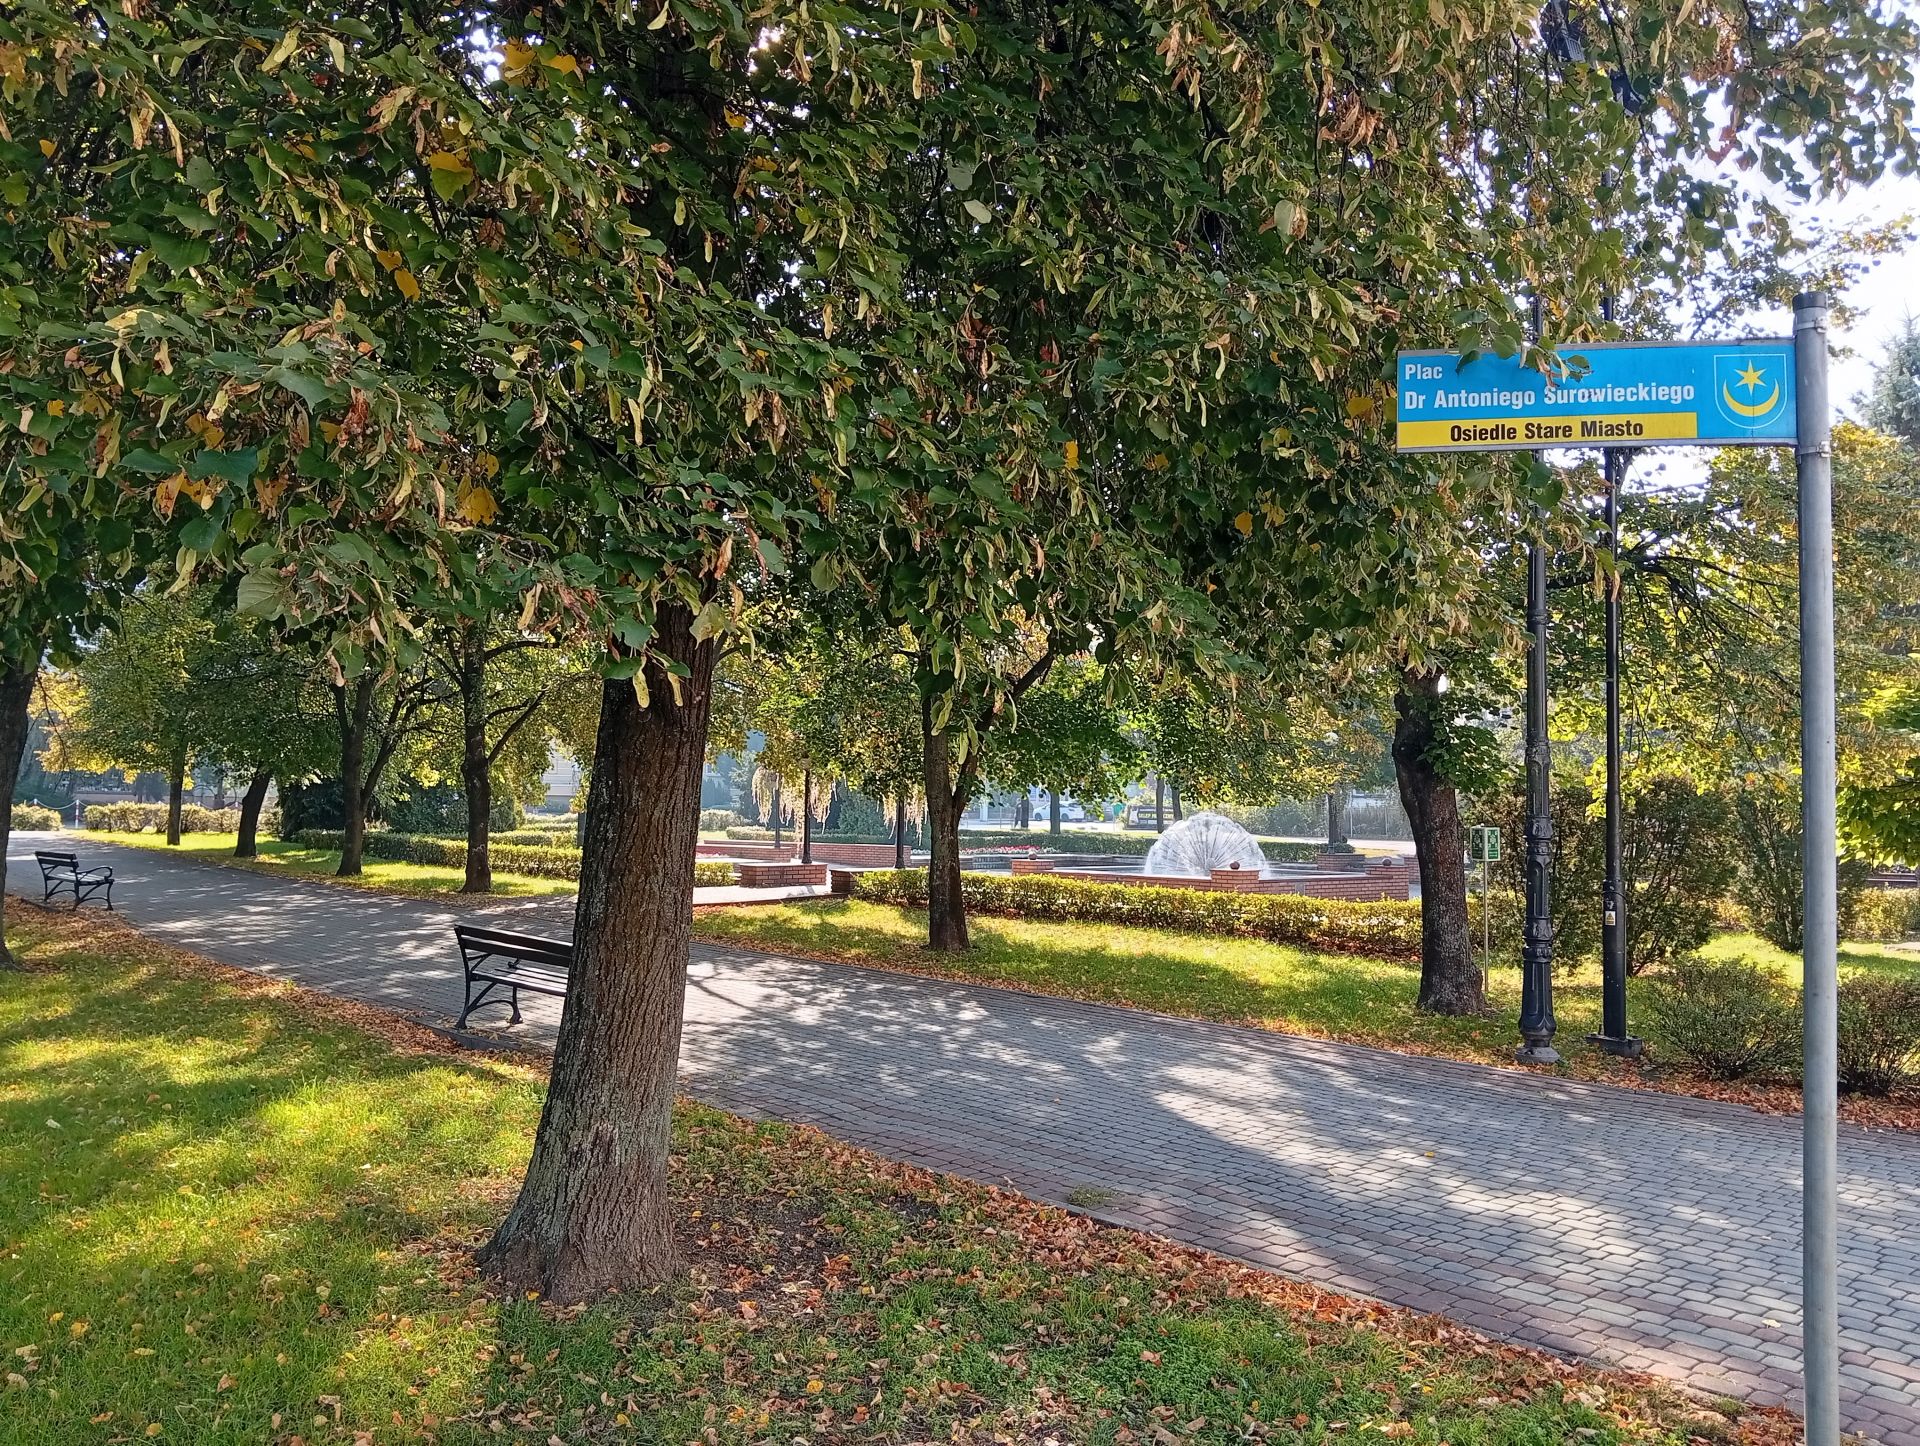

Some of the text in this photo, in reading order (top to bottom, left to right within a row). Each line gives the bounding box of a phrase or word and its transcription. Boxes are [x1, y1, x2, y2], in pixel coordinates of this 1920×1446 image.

[1405, 363, 1443, 380] Plac
[1404, 382, 1695, 410] Dr Antoniego Surowieckiego
[1450, 420, 1644, 442] Osiedle Stare Miasto
